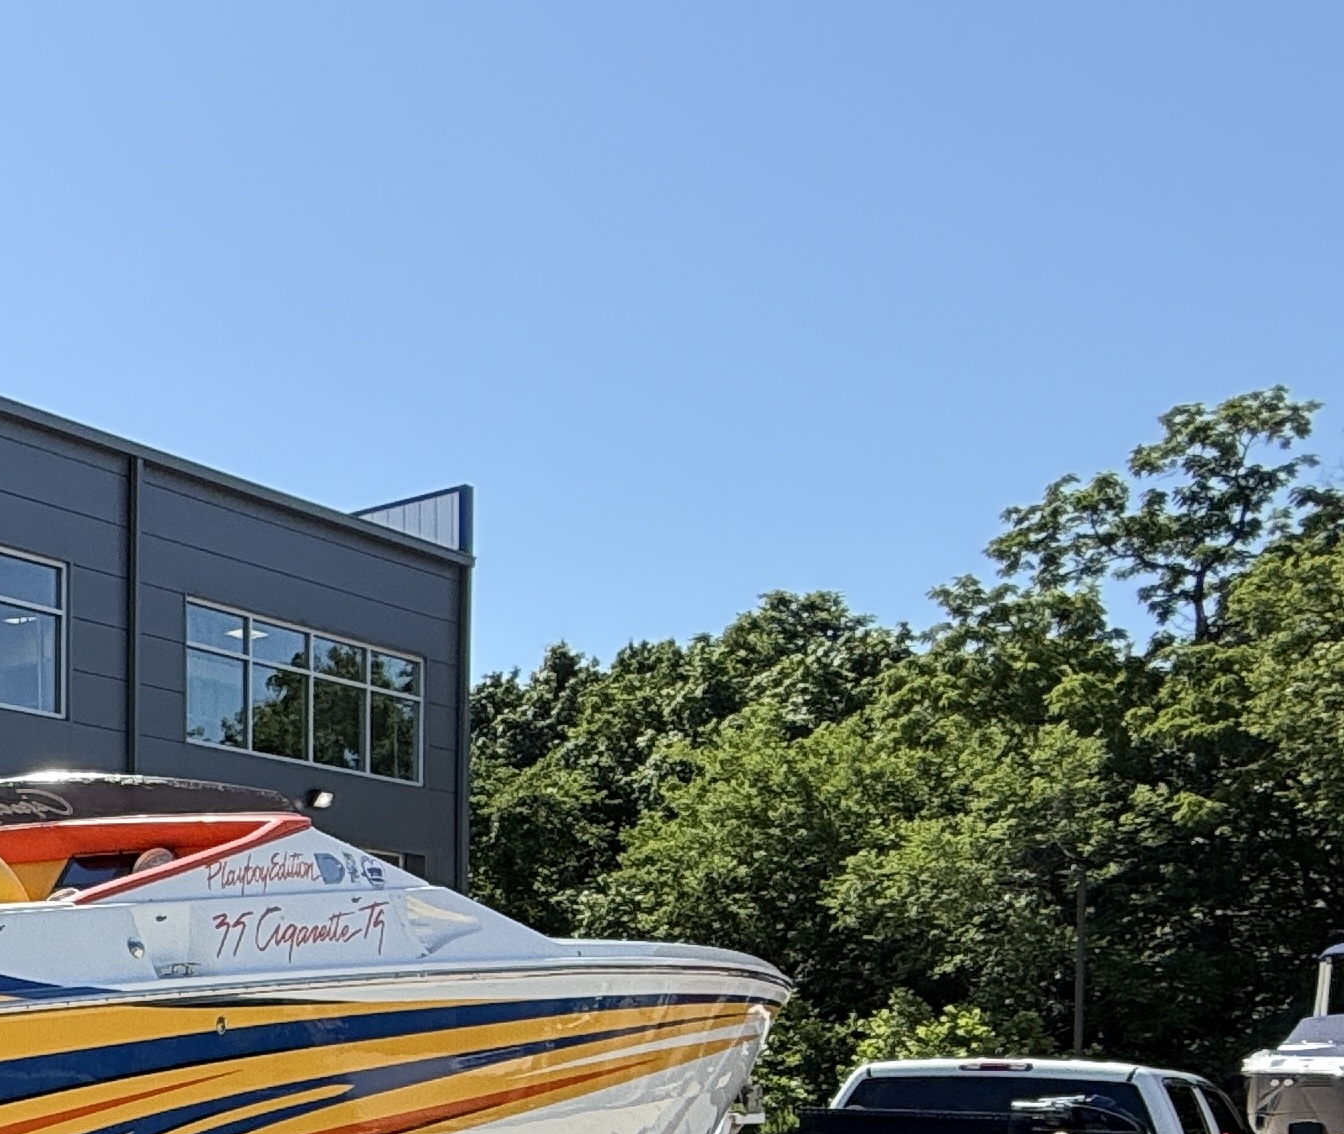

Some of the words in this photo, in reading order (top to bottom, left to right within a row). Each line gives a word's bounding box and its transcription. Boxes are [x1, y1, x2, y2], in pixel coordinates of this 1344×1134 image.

[205, 853, 270, 896] Playboy
[269, 850, 323, 882] Edition
[212, 910, 254, 959] 35
[254, 906, 363, 964] Cigarette
